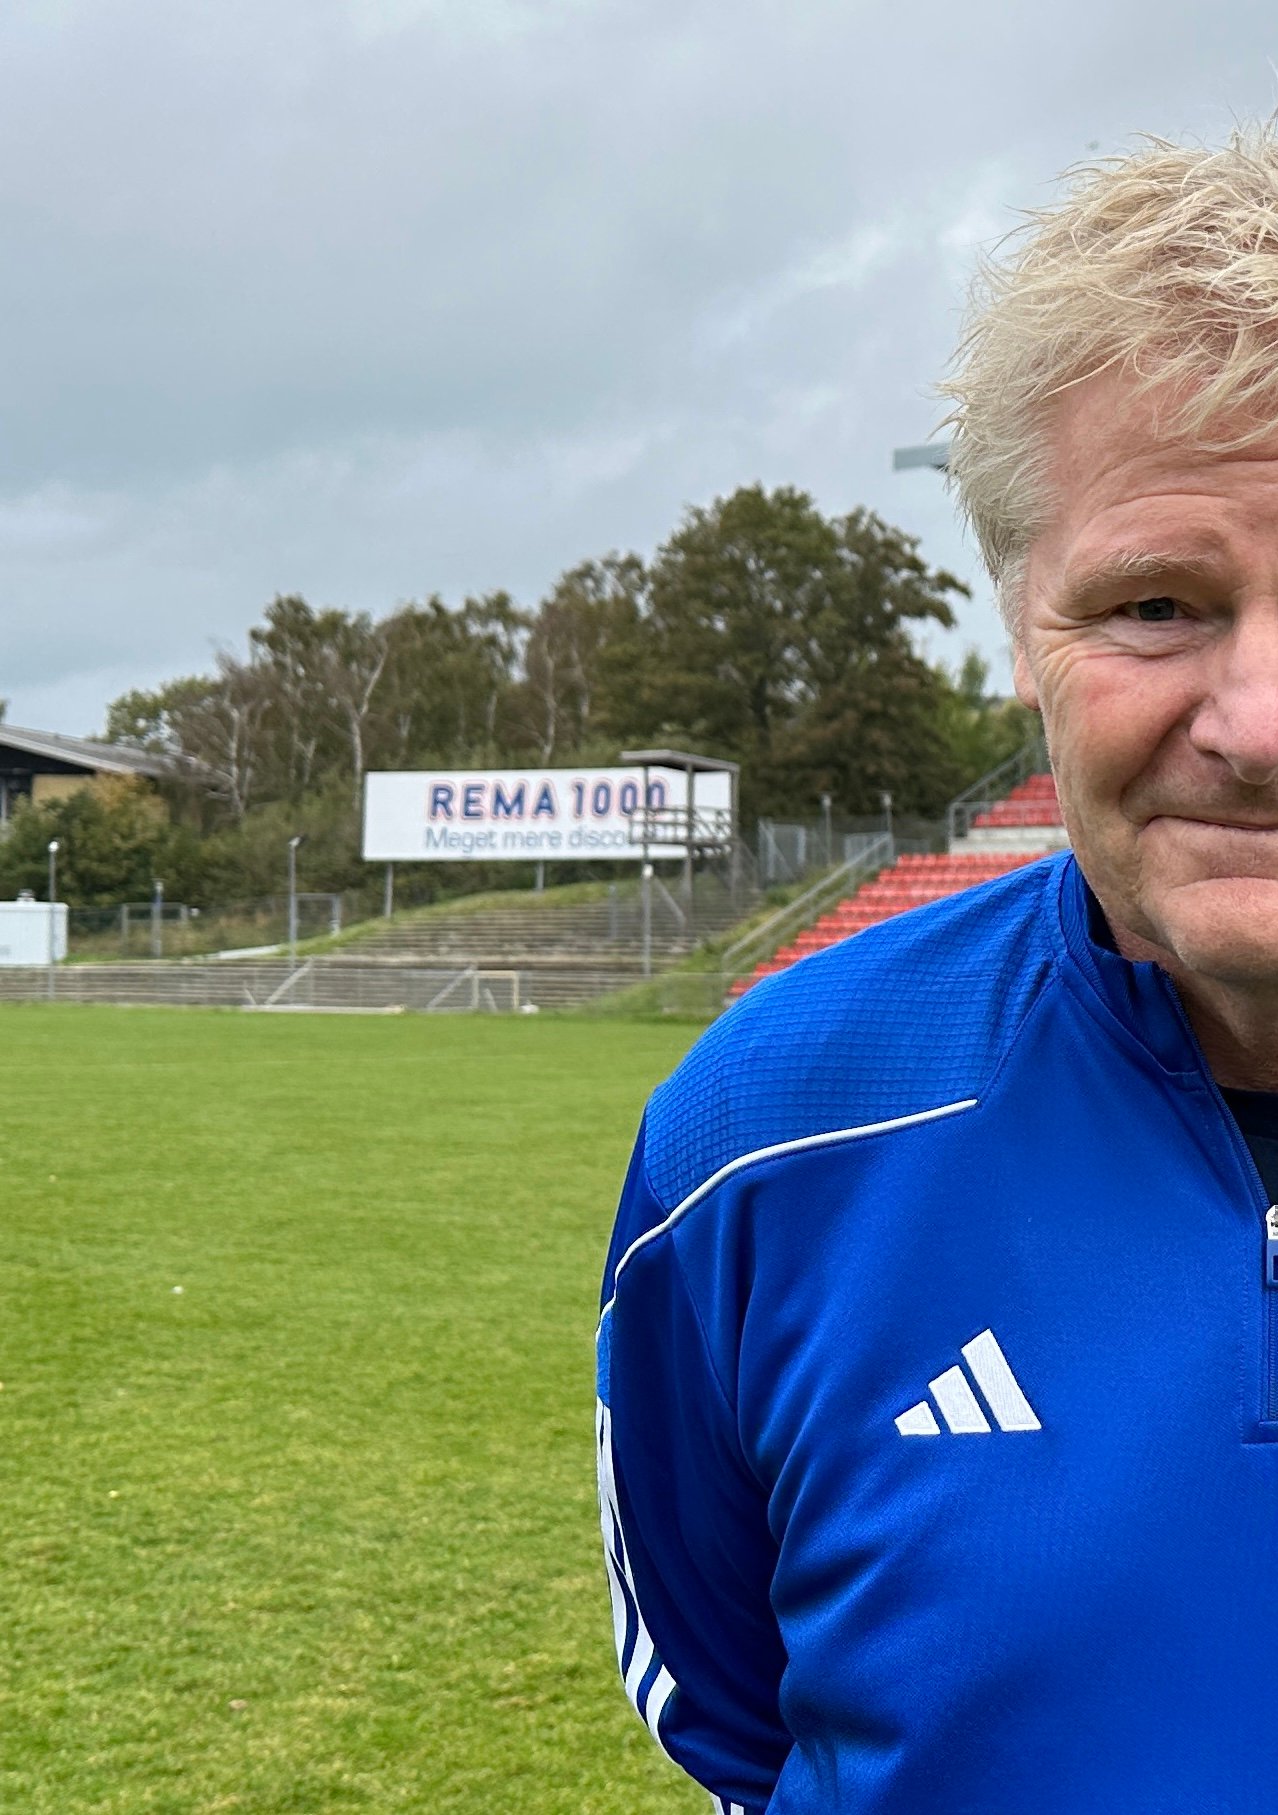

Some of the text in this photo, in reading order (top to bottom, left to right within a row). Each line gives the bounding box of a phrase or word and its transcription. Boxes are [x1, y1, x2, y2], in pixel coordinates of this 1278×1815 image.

[429, 780, 556, 822] REMA
[425, 828, 496, 853] Meget
[503, 829, 562, 849] mere
